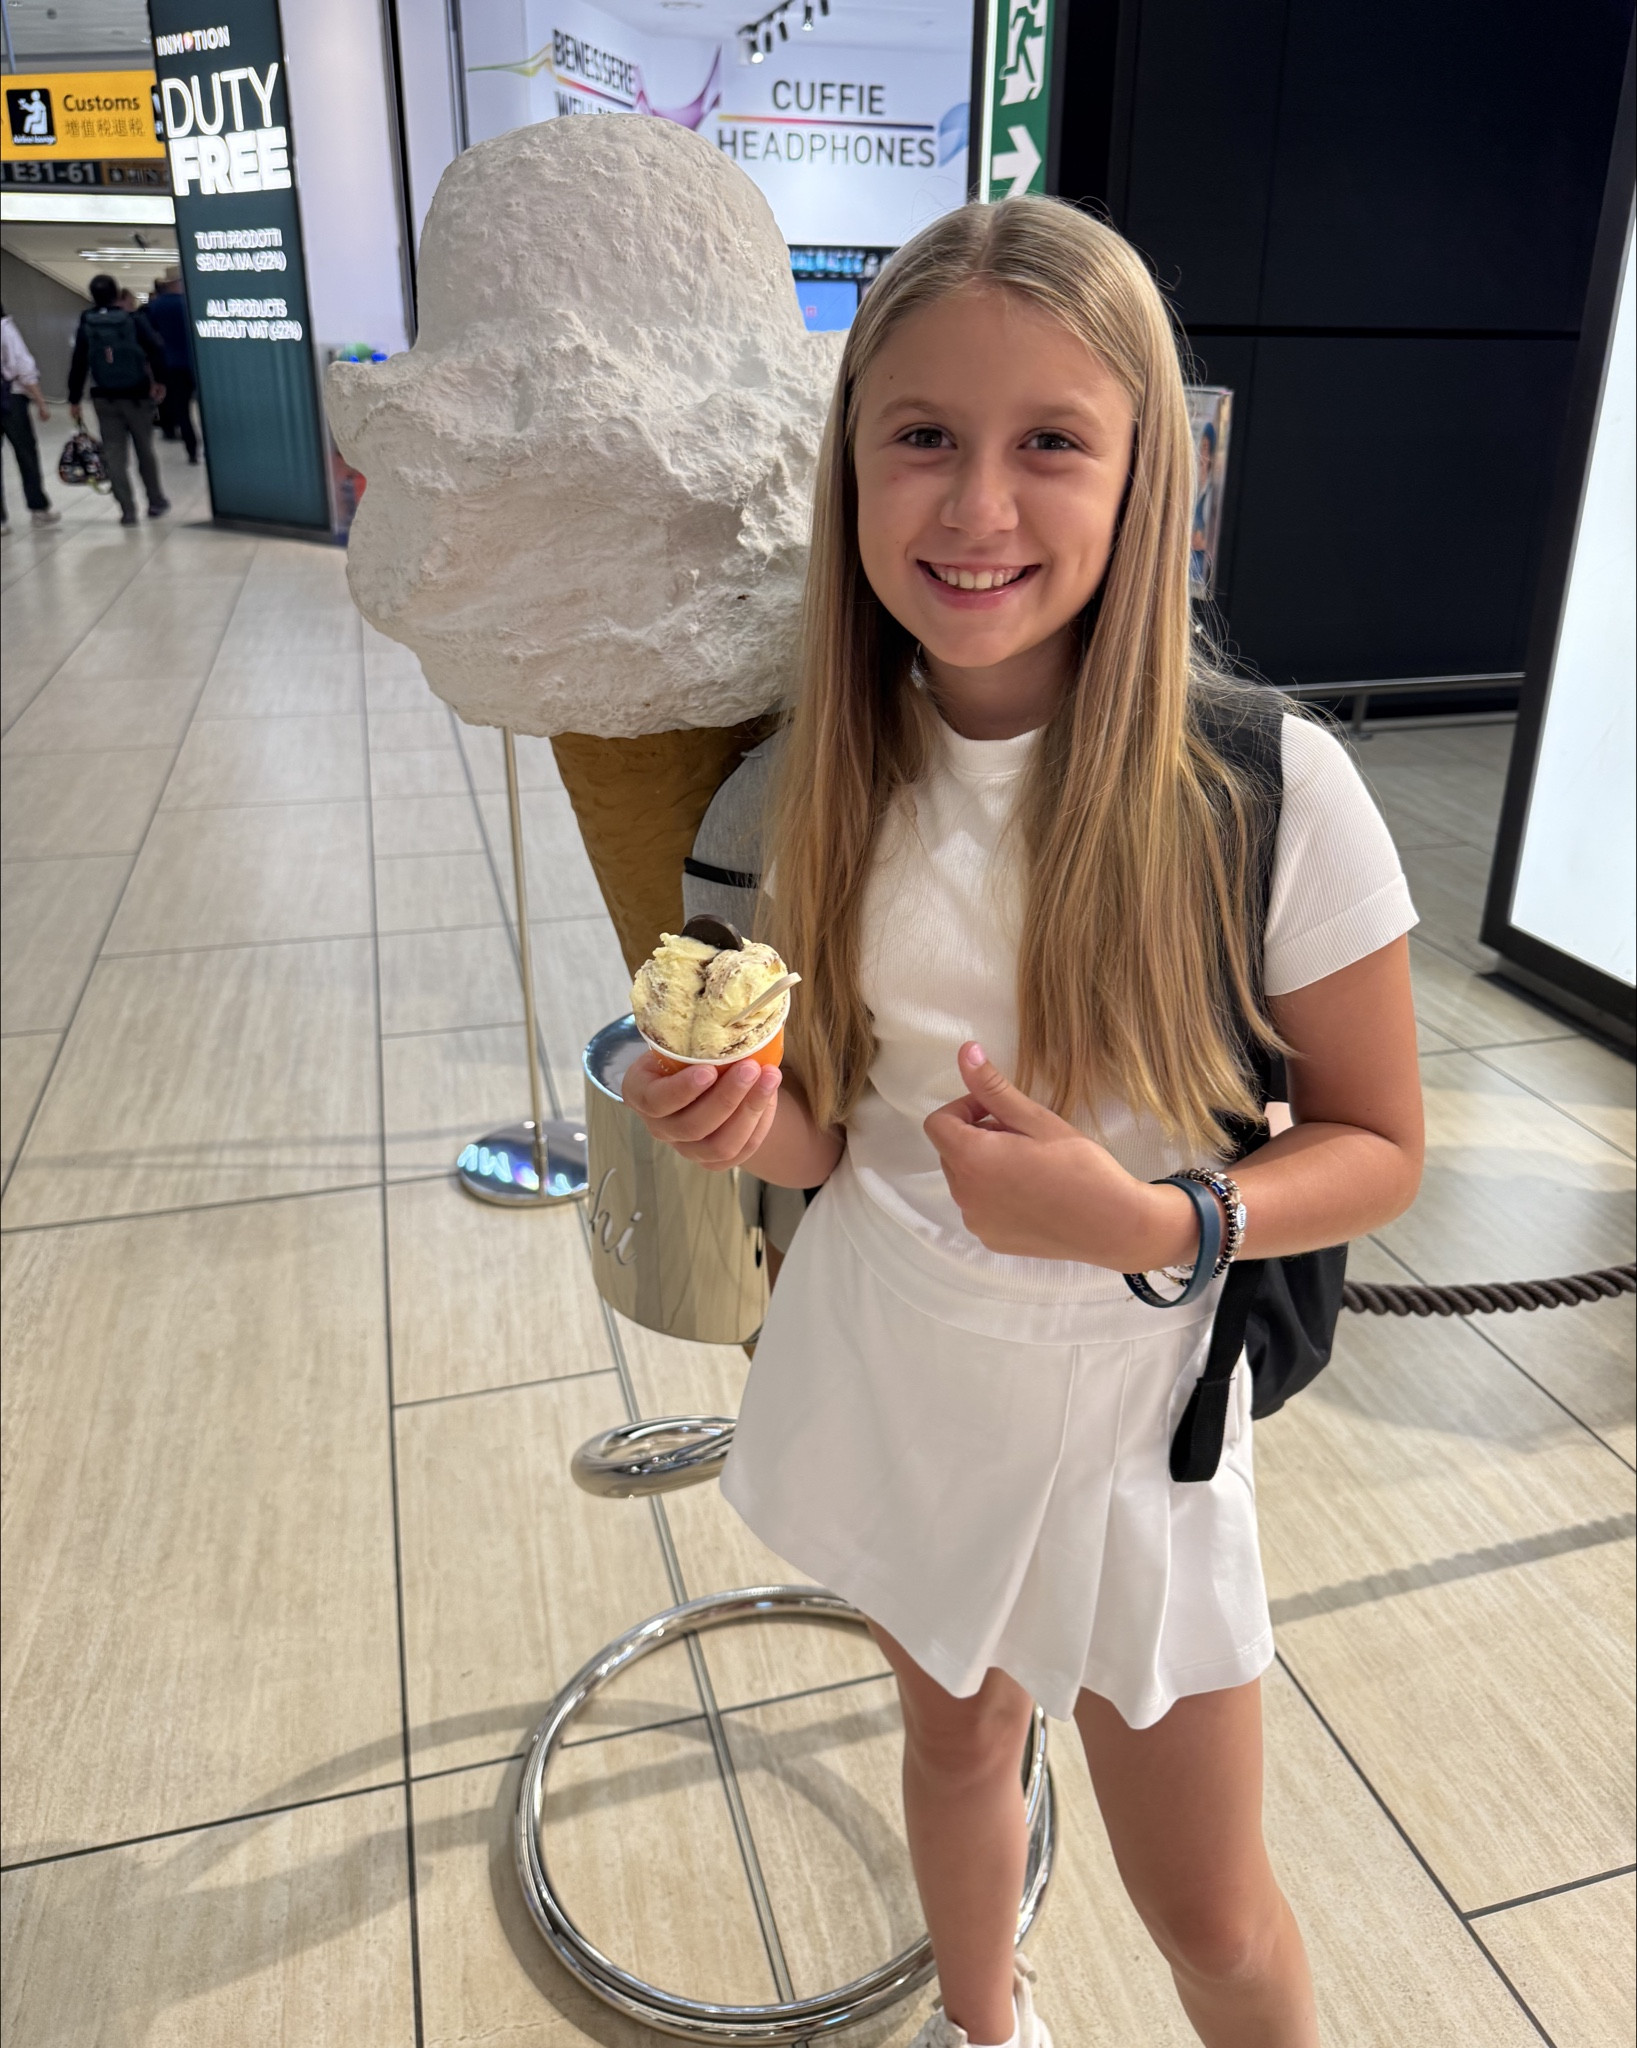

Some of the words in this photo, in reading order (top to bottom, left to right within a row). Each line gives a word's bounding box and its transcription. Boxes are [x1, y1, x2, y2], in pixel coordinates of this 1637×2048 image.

[552, 28, 640, 96] BENESSERE
[63, 94, 141, 112] Customs
[161, 62, 279, 138] DUTY
[772, 79, 886, 116] CUFFIE
[718, 129, 936, 168] HEADPHONES
[11, 161, 97, 185] E31-61
[168, 127, 292, 197] FREE
[194, 231, 227, 250] TUTTI
[227, 228, 283, 248] PRODOTTI
[196, 252, 234, 272] SENZA
[232, 252, 254, 271] IVA
[206, 299, 229, 318] ALL
[227, 298, 288, 318] PRODUCTS
[196, 320, 247, 339] WITHOUT
[246, 320, 269, 339] VAT
